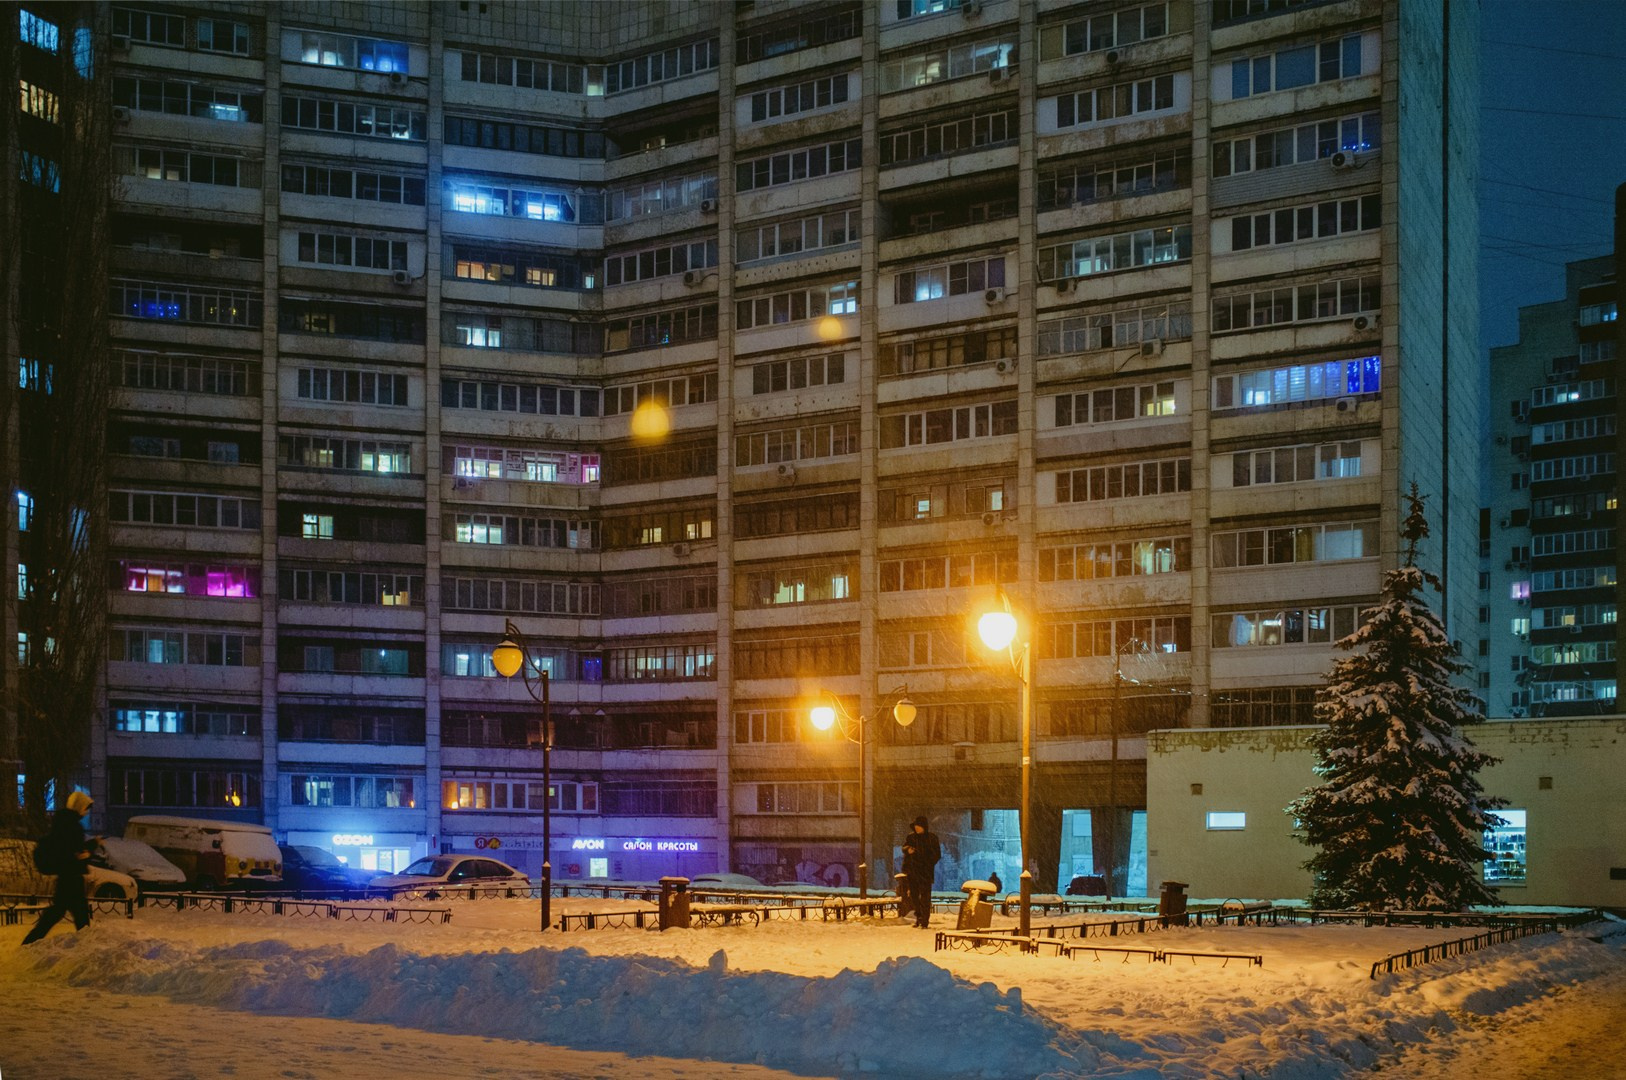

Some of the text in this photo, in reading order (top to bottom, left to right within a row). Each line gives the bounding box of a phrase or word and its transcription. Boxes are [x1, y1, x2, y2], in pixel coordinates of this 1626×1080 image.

[332, 834, 374, 846] OZON
[572, 839, 604, 850] AVON
[623, 841, 698, 851] САЛОН КРАСОТЫ
